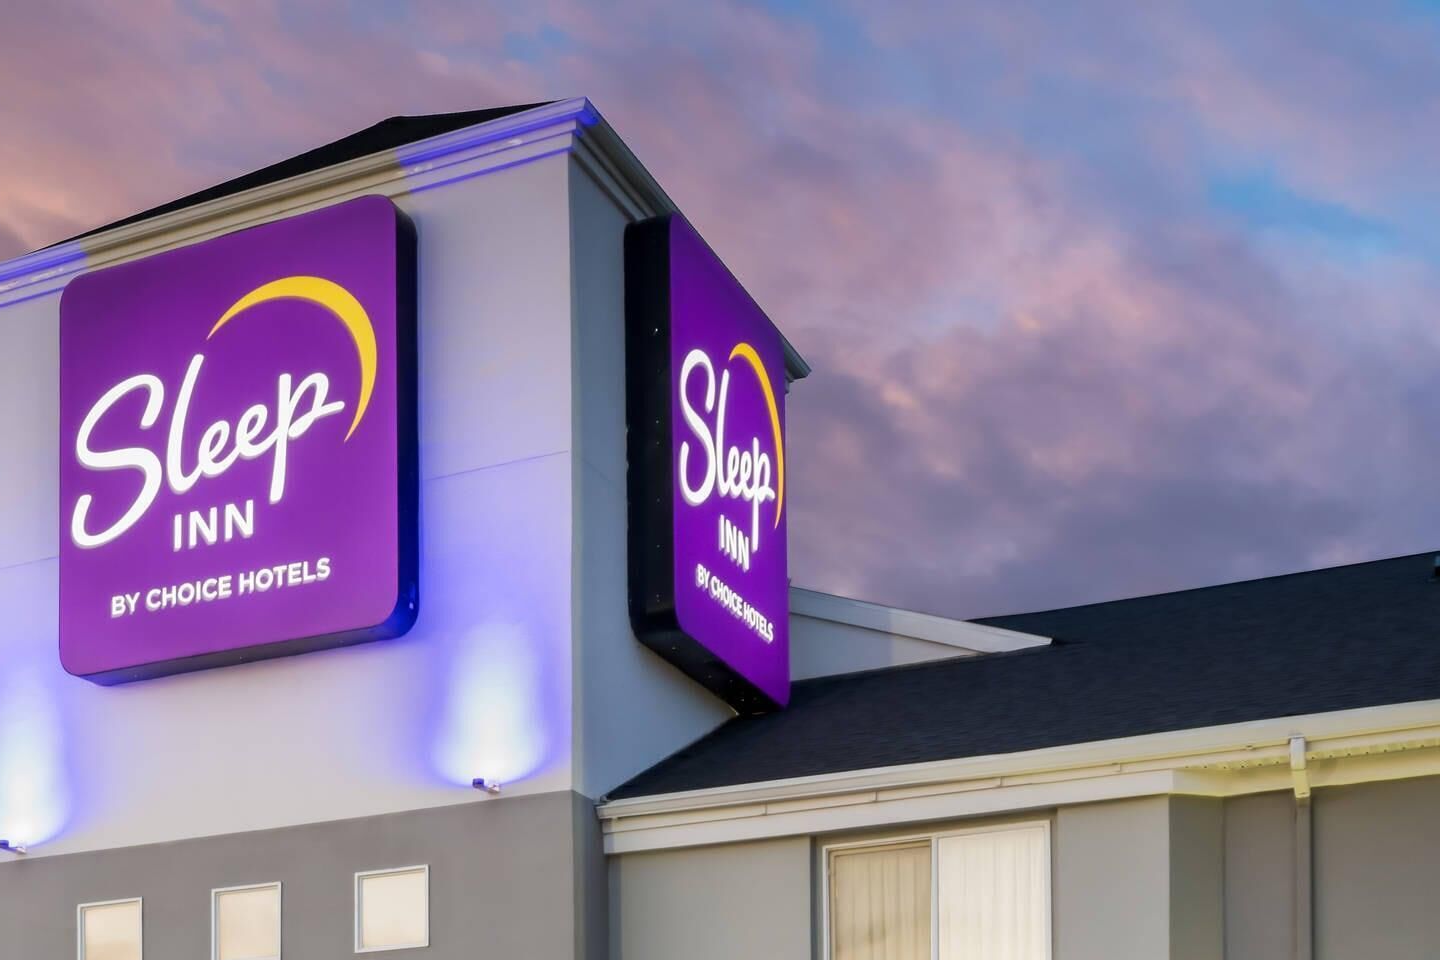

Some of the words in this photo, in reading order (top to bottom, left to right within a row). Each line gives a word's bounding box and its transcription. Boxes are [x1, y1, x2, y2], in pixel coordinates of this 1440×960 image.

[71, 354, 345, 548] Sleep
[680, 348, 775, 553] Sleep
[173, 499, 254, 552] INN
[719, 514, 750, 572] INN
[111, 592, 141, 618] BY
[146, 575, 232, 611] CHOICE
[238, 557, 331, 596] HOTELS
[696, 563, 711, 591] BY
[709, 575, 743, 620] CHOICE
[742, 602, 774, 644] HOTELS
